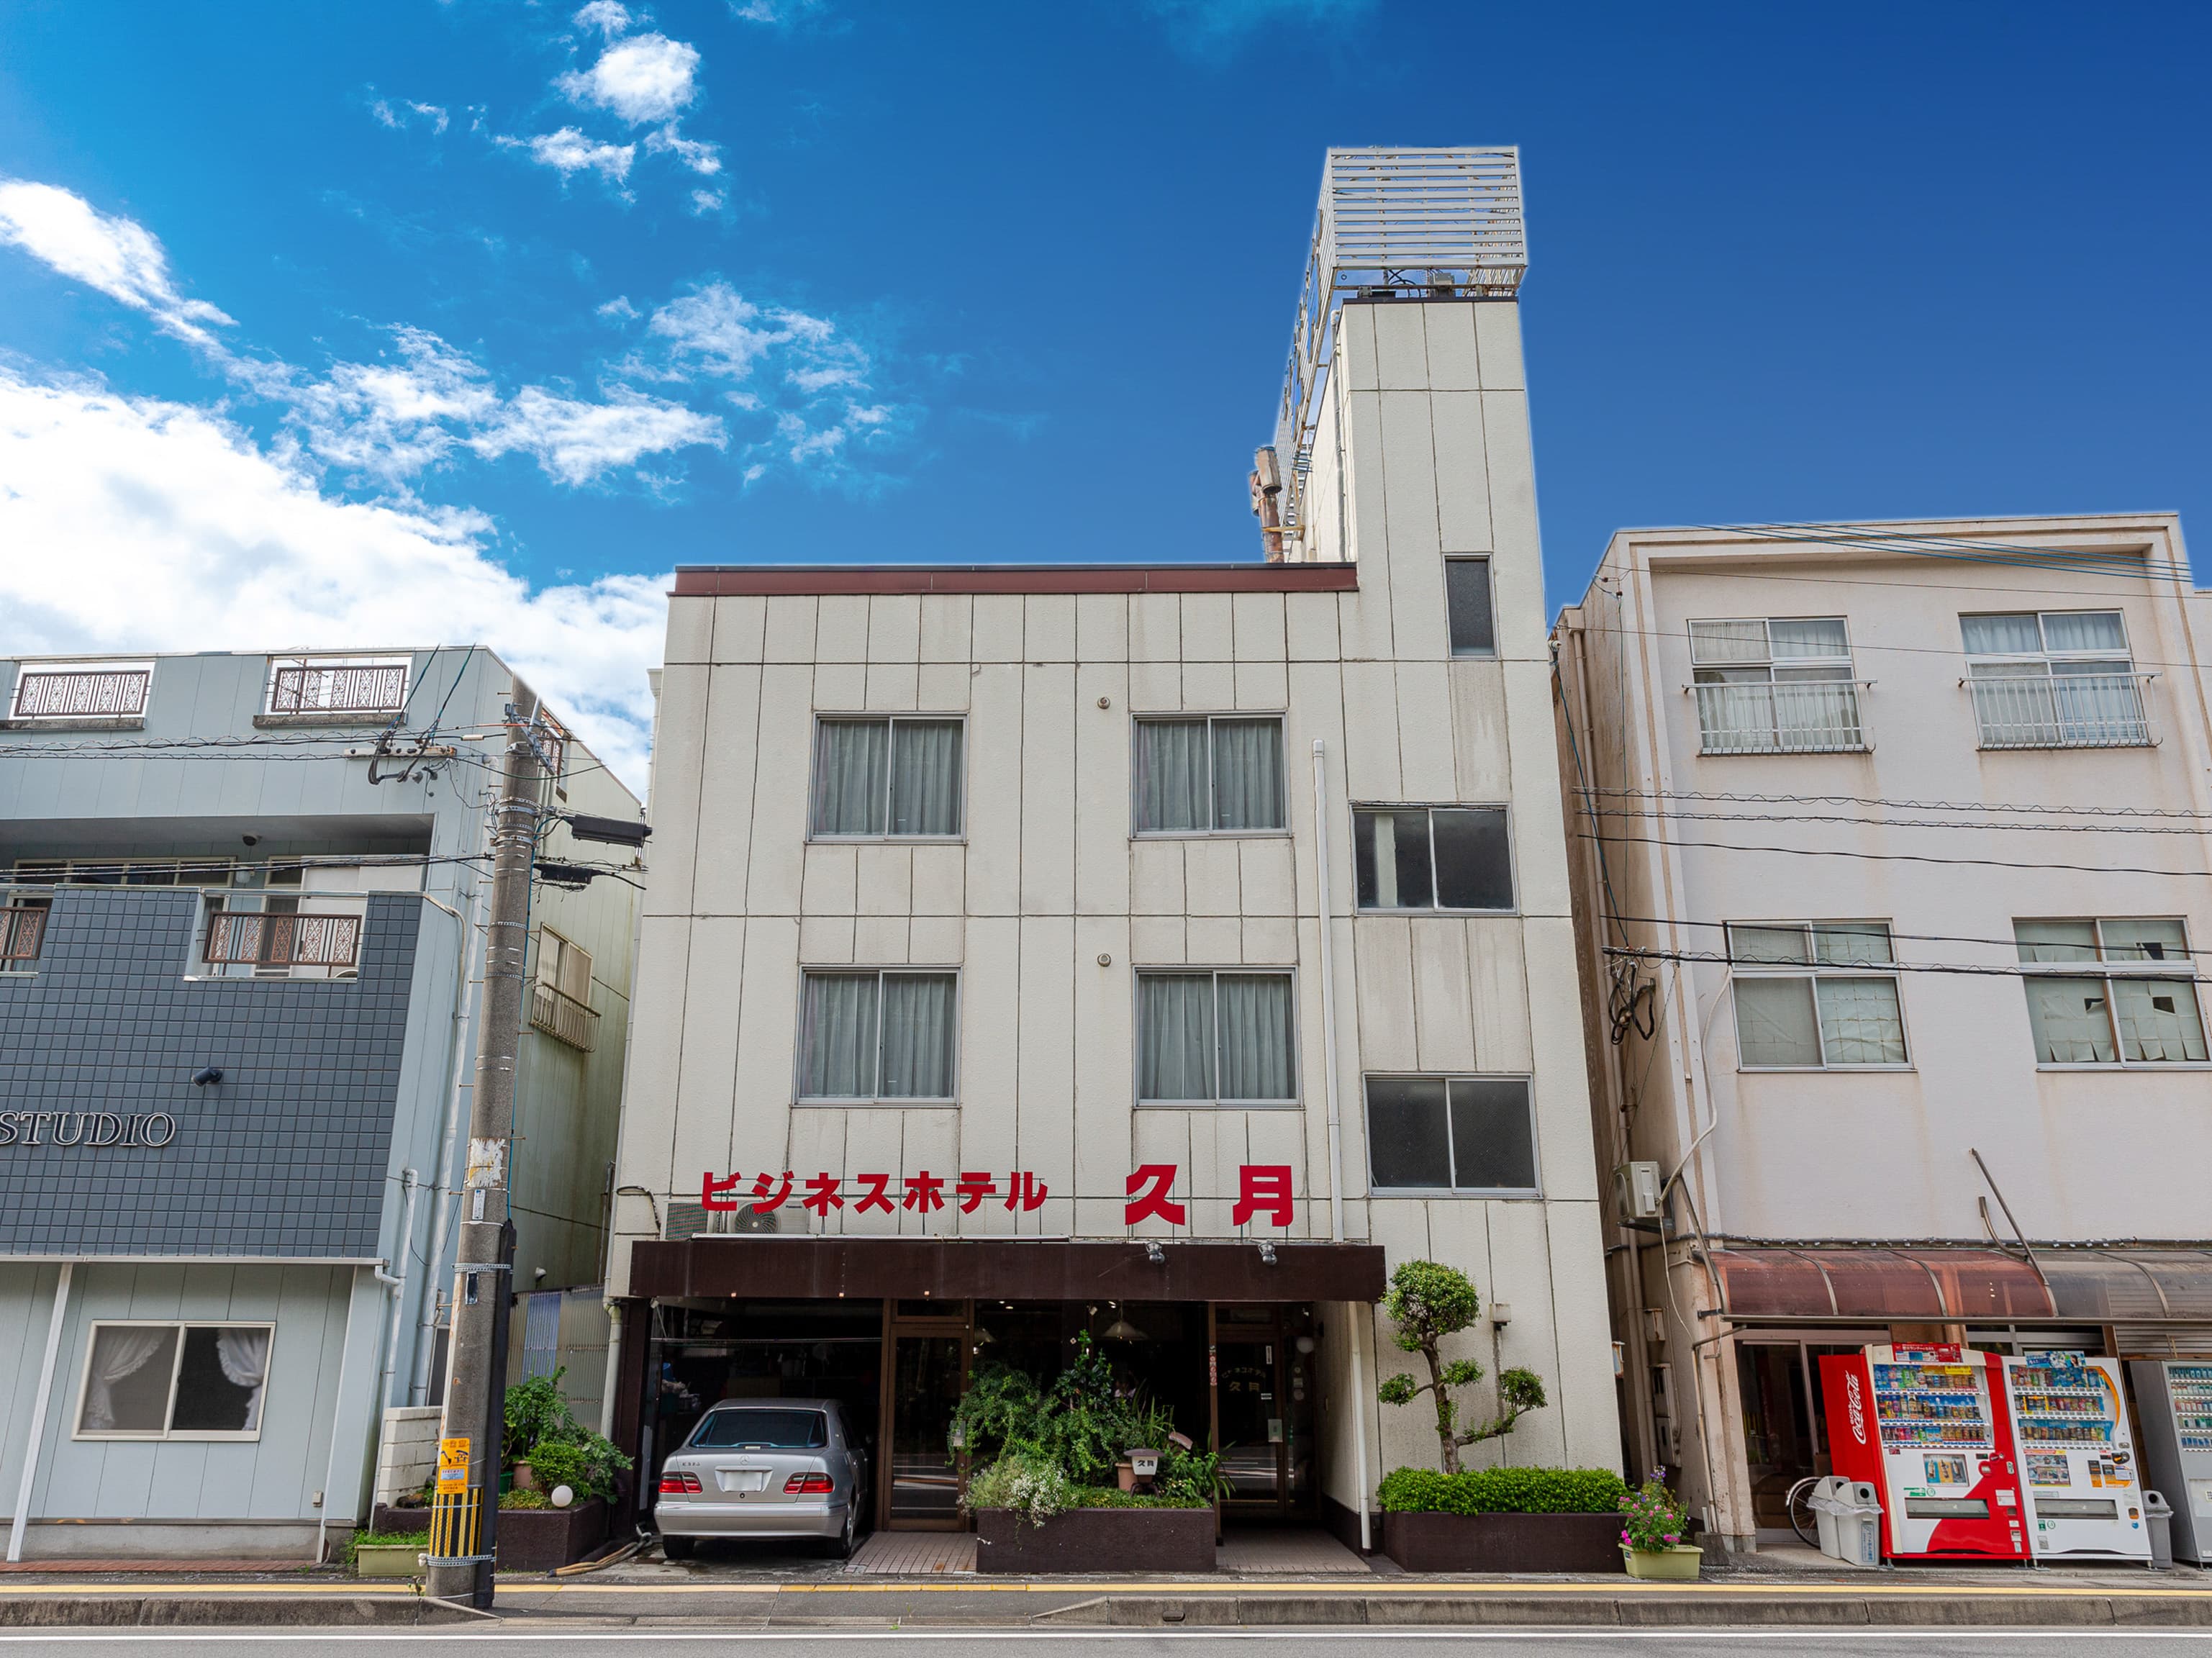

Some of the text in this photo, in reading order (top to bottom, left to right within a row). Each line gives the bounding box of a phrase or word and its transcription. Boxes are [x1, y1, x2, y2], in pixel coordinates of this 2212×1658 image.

[0, 1110, 176, 1146] STUDIO
[702, 1164, 1294, 1227] ビジネスホテル 久月
[1845, 1369, 1867, 1445] Coca-Cola
